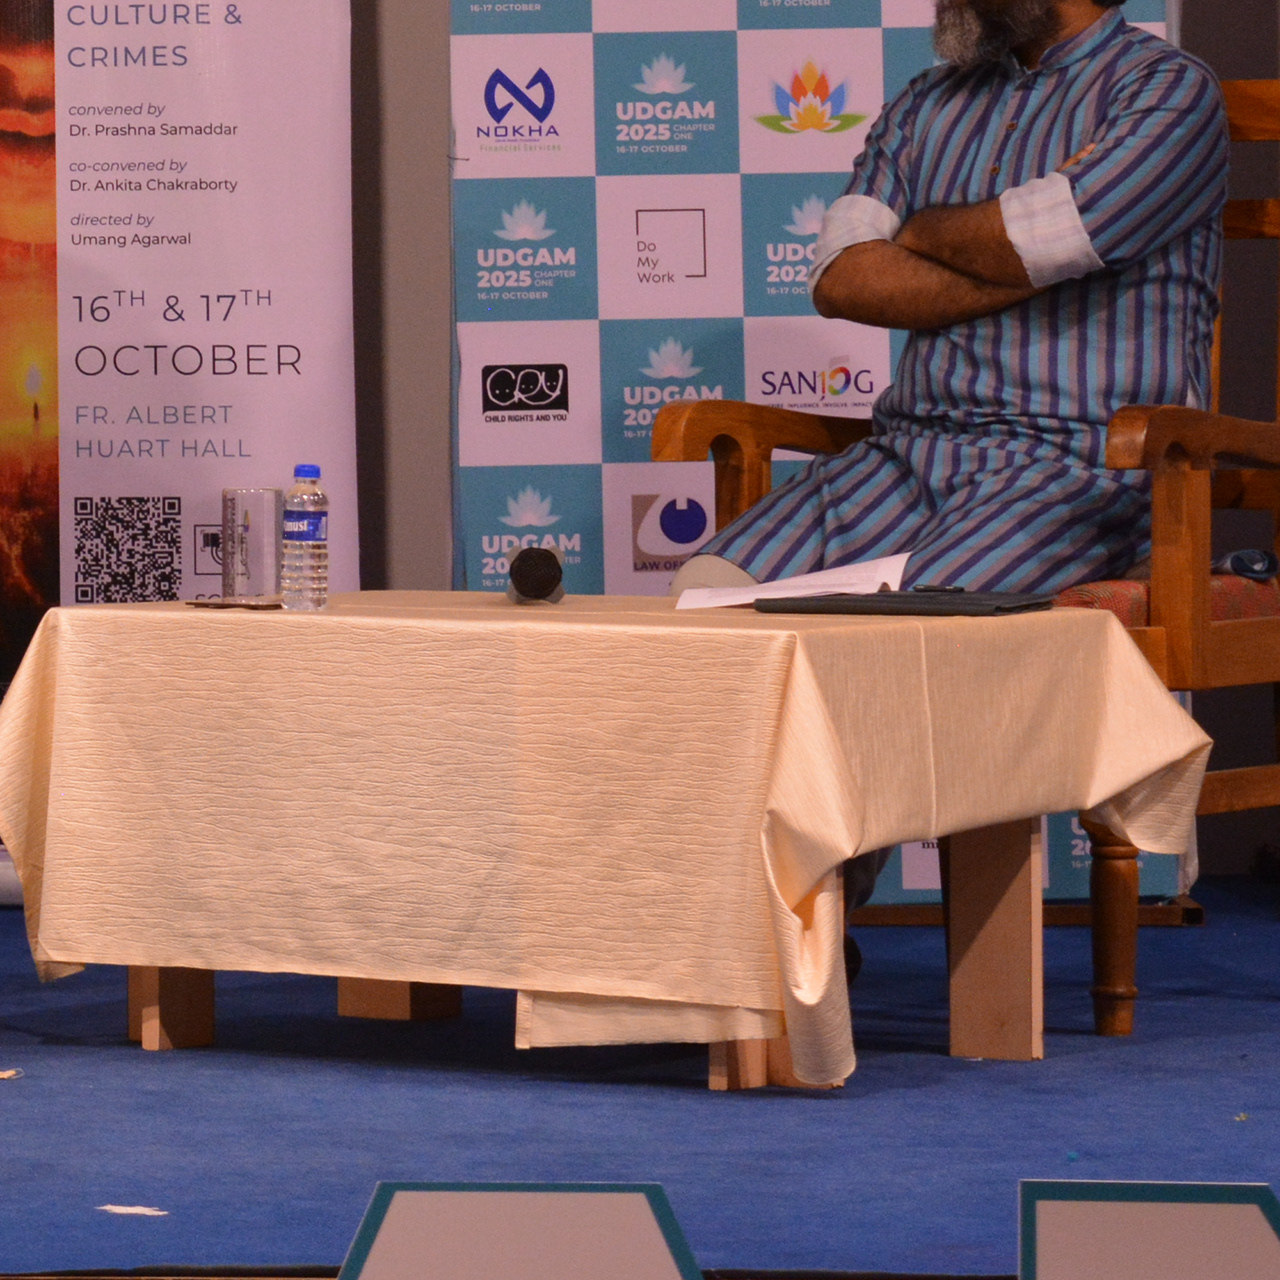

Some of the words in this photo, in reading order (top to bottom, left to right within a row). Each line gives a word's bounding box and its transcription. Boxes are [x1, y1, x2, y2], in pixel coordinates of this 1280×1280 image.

[67, 4, 210, 26] CULTURE
[224, 4, 242, 24] &
[68, 46, 187, 67] CRIMES
[69, 103, 143, 115] convened
[147, 103, 166, 118] by
[616, 101, 715, 120] UDGAM
[70, 124, 90, 136] Dr.
[95, 124, 155, 136] Prashna
[160, 123, 237, 135] Samaddar
[477, 125, 559, 137] NOKHA
[616, 124, 671, 141] 2025
[673, 132, 692, 140] ONE
[641, 145, 687, 153] OCTOBER
[69, 159, 165, 172] co-convened
[169, 159, 187, 173] by
[70, 180, 90, 191] Dr.
[94, 179, 142, 191] Ankita
[146, 178, 237, 193] Chakraborty
[71, 214, 133, 226] directed
[137, 214, 154, 228] by
[72, 234, 126, 248] Umang
[131, 233, 191, 248] Agarwal
[637, 241, 656, 252] Do
[637, 257, 658, 270] My
[637, 272, 674, 283] Work
[73, 291, 144, 322] 16TH
[163, 295, 185, 322] &
[200, 290, 271, 321] 17TH
[75, 345, 300, 376] OCTOBER
[486, 368, 563, 406] CRY
[76, 406, 115, 424] FR.
[126, 405, 232, 424] ALBERT
[76, 439, 170, 458] HUART
[182, 439, 251, 458] HALL
